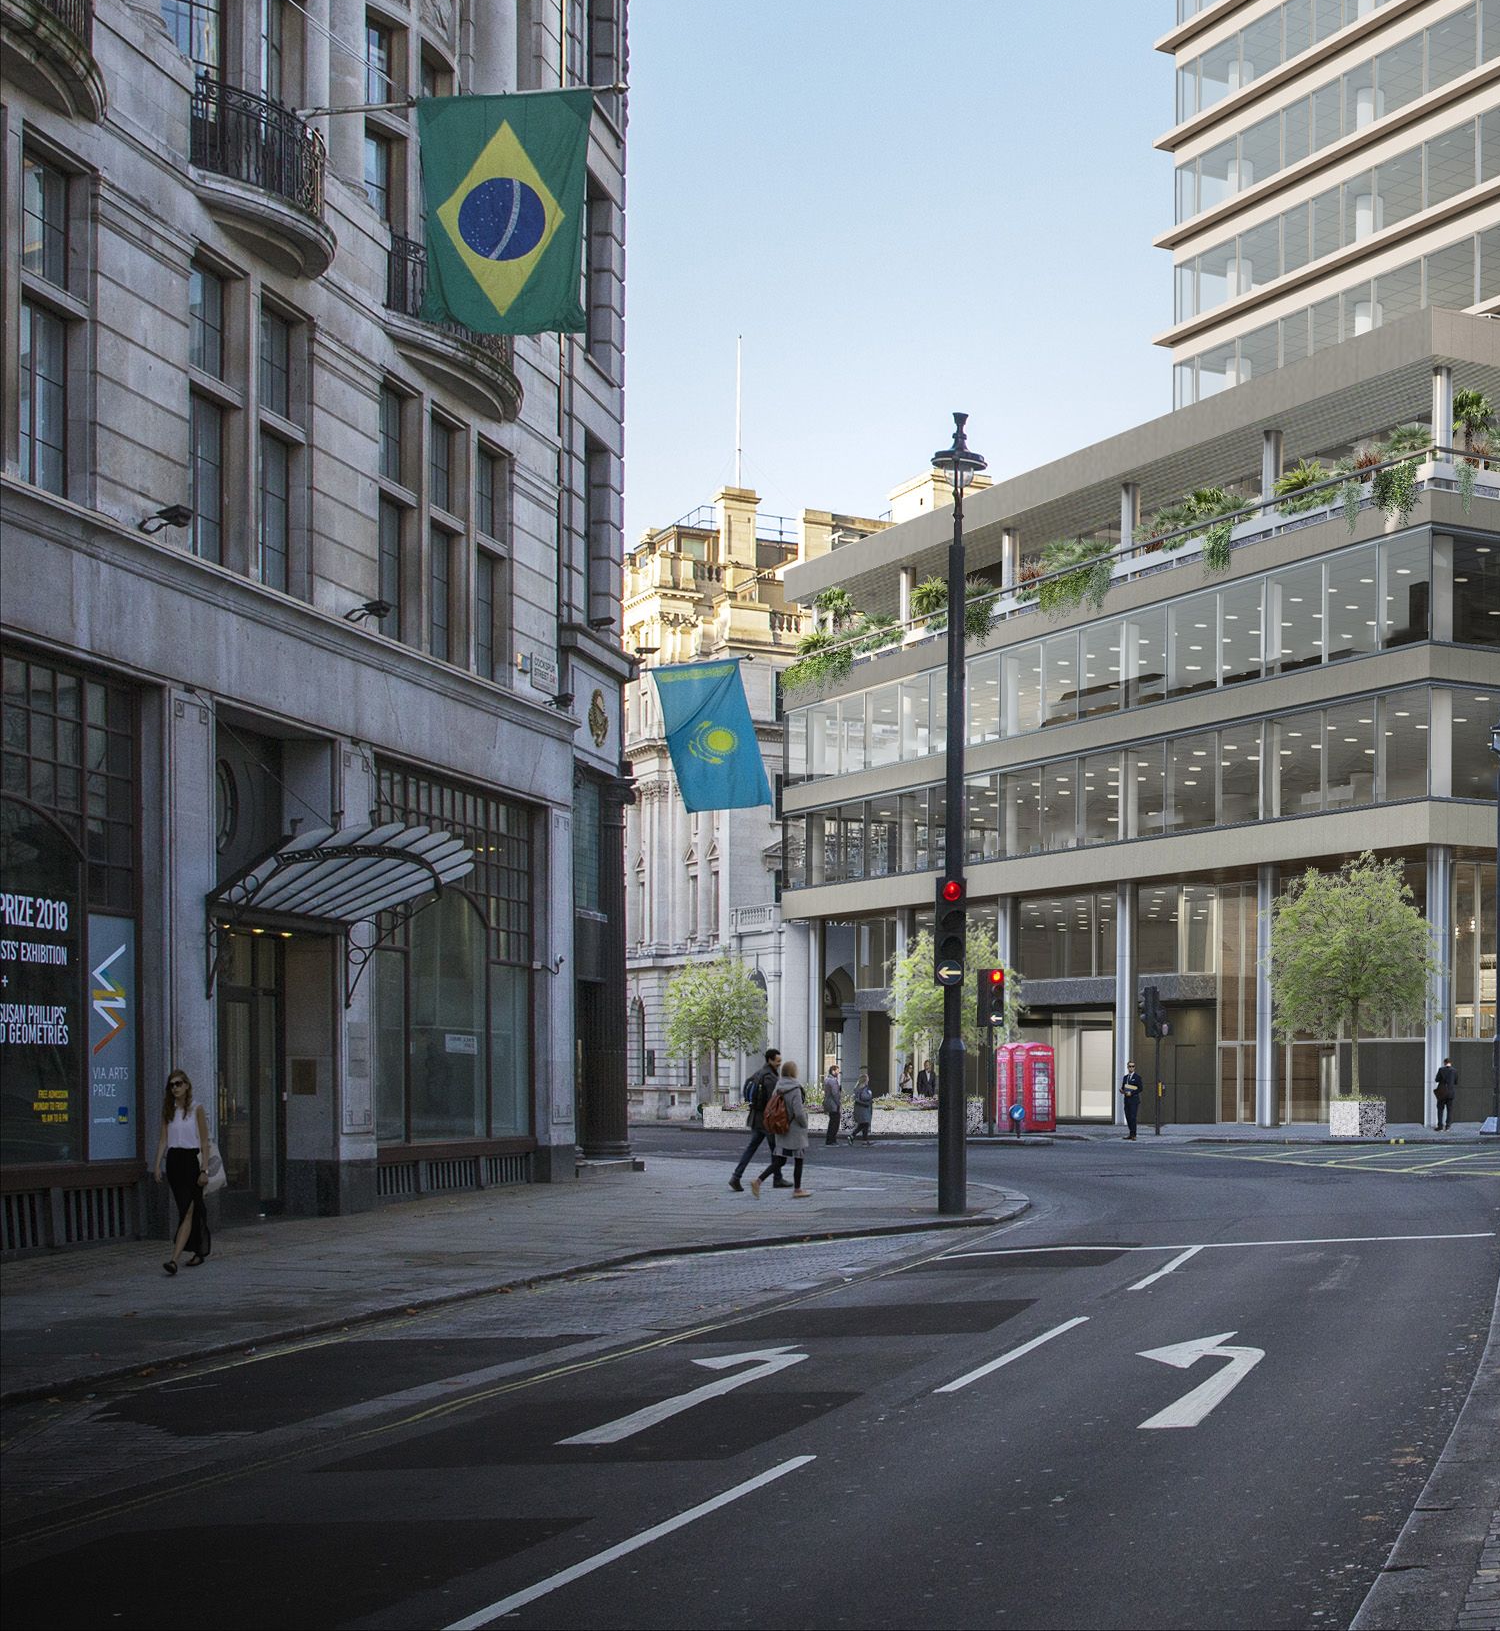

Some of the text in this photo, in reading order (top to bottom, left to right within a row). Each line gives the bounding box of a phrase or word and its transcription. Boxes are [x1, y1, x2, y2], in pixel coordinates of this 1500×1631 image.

[535, 668, 549, 681] STREET
[36, 898, 68, 931] 2018
[21, 942, 68, 965] EXHIBITION
[0, 1003, 67, 1025] SUSAN PHILLIPS'
[9, 1023, 69, 1045] GEOMETRIES
[92, 1067, 129, 1080] VIA ARTS
[93, 1084, 116, 1097] PRIZE
